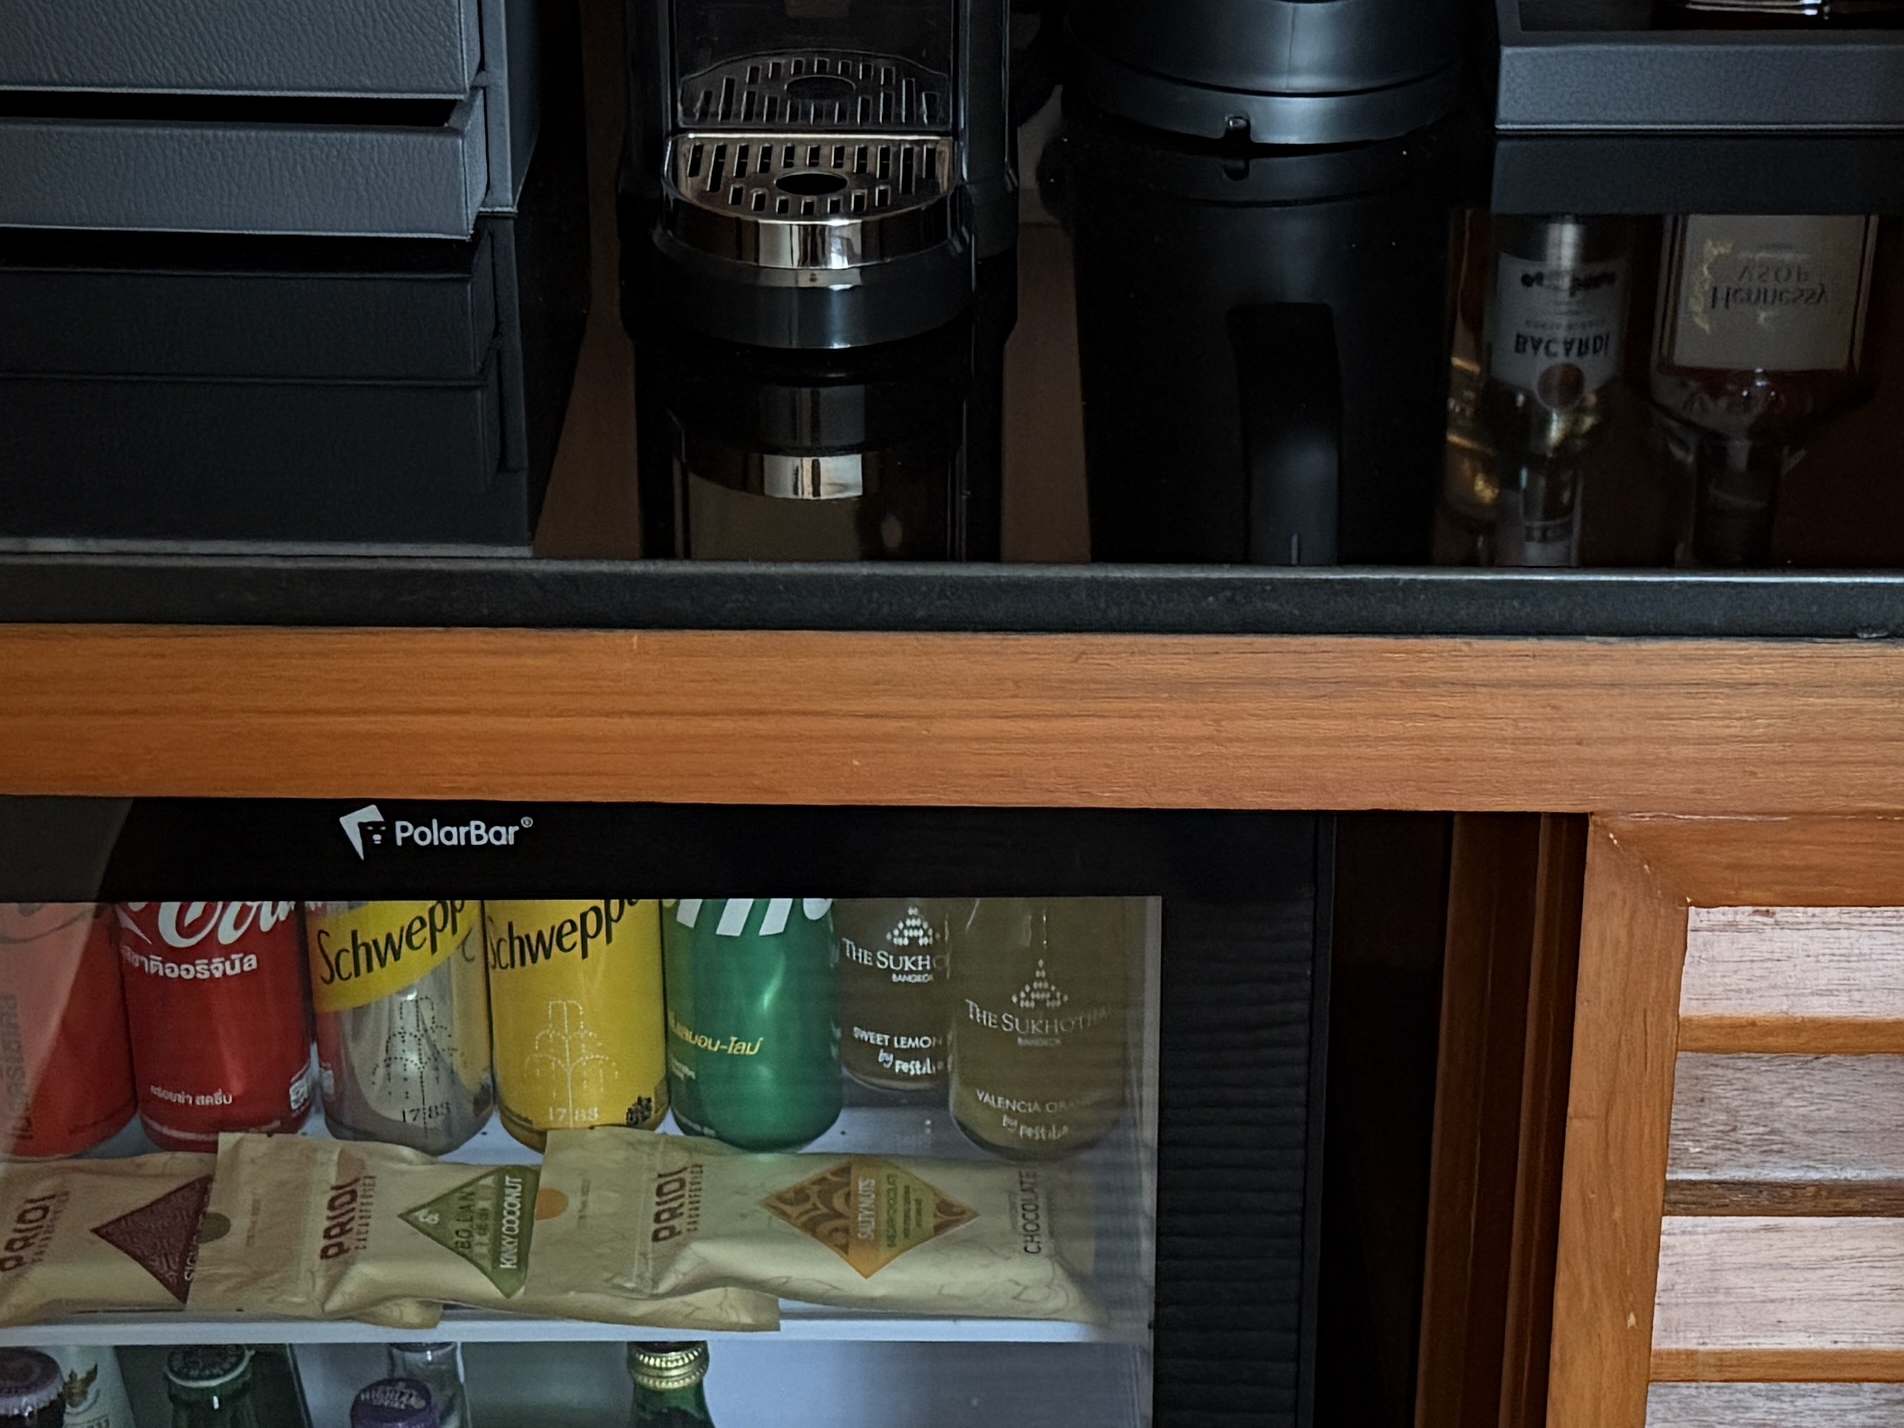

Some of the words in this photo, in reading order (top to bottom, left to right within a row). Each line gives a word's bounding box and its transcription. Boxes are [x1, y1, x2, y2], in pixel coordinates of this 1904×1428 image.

[316, 900, 466, 987] Schwepp
[842, 937, 873, 967] THE
[965, 997, 999, 1030] THE
[976, 1088, 1042, 1114] VALENCIA
[319, 1177, 361, 1261] PRIDI
[501, 1174, 524, 1235] COCONUT
[651, 1167, 689, 1243] PRIDI
[499, 1236, 519, 1269] KINKY
